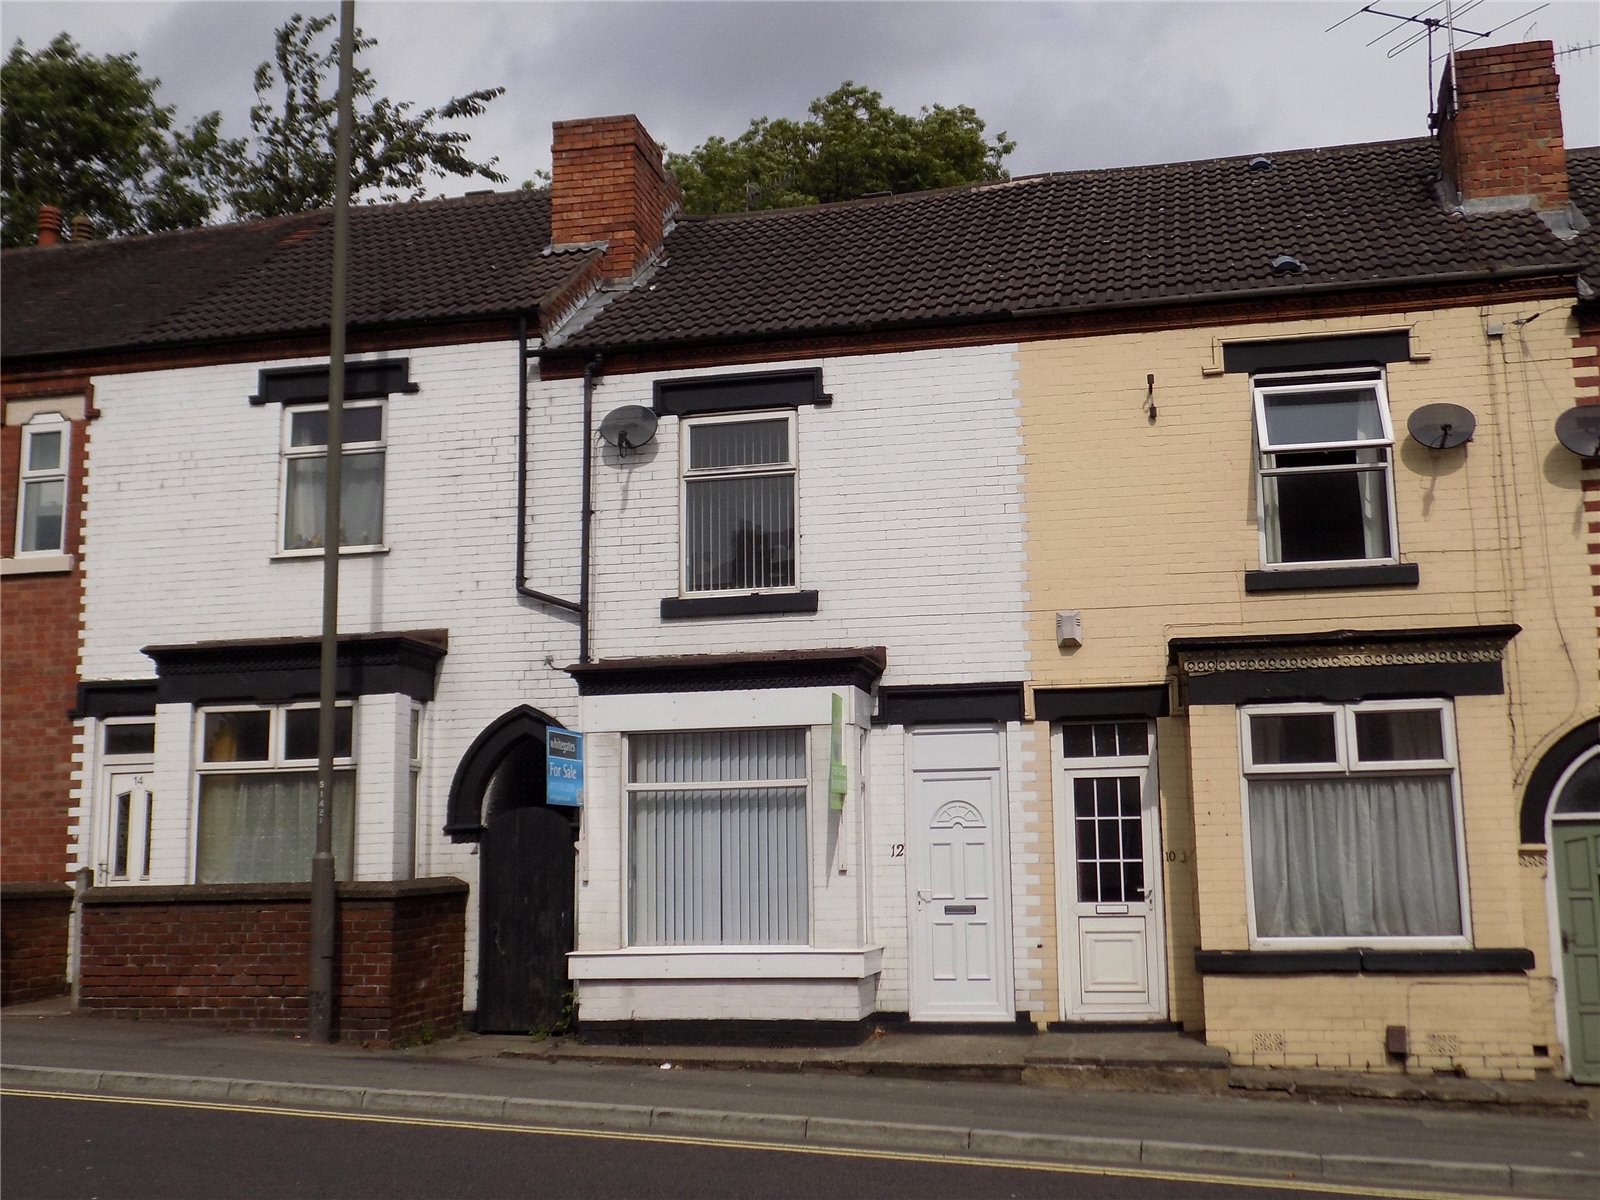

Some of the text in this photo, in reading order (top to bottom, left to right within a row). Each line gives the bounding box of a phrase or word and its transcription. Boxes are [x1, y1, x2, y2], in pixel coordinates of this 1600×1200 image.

[549, 762, 577, 780] For Sale
[133, 776, 143, 785] 14
[890, 843, 904, 858] 12
[1165, 851, 1176, 862] 10
